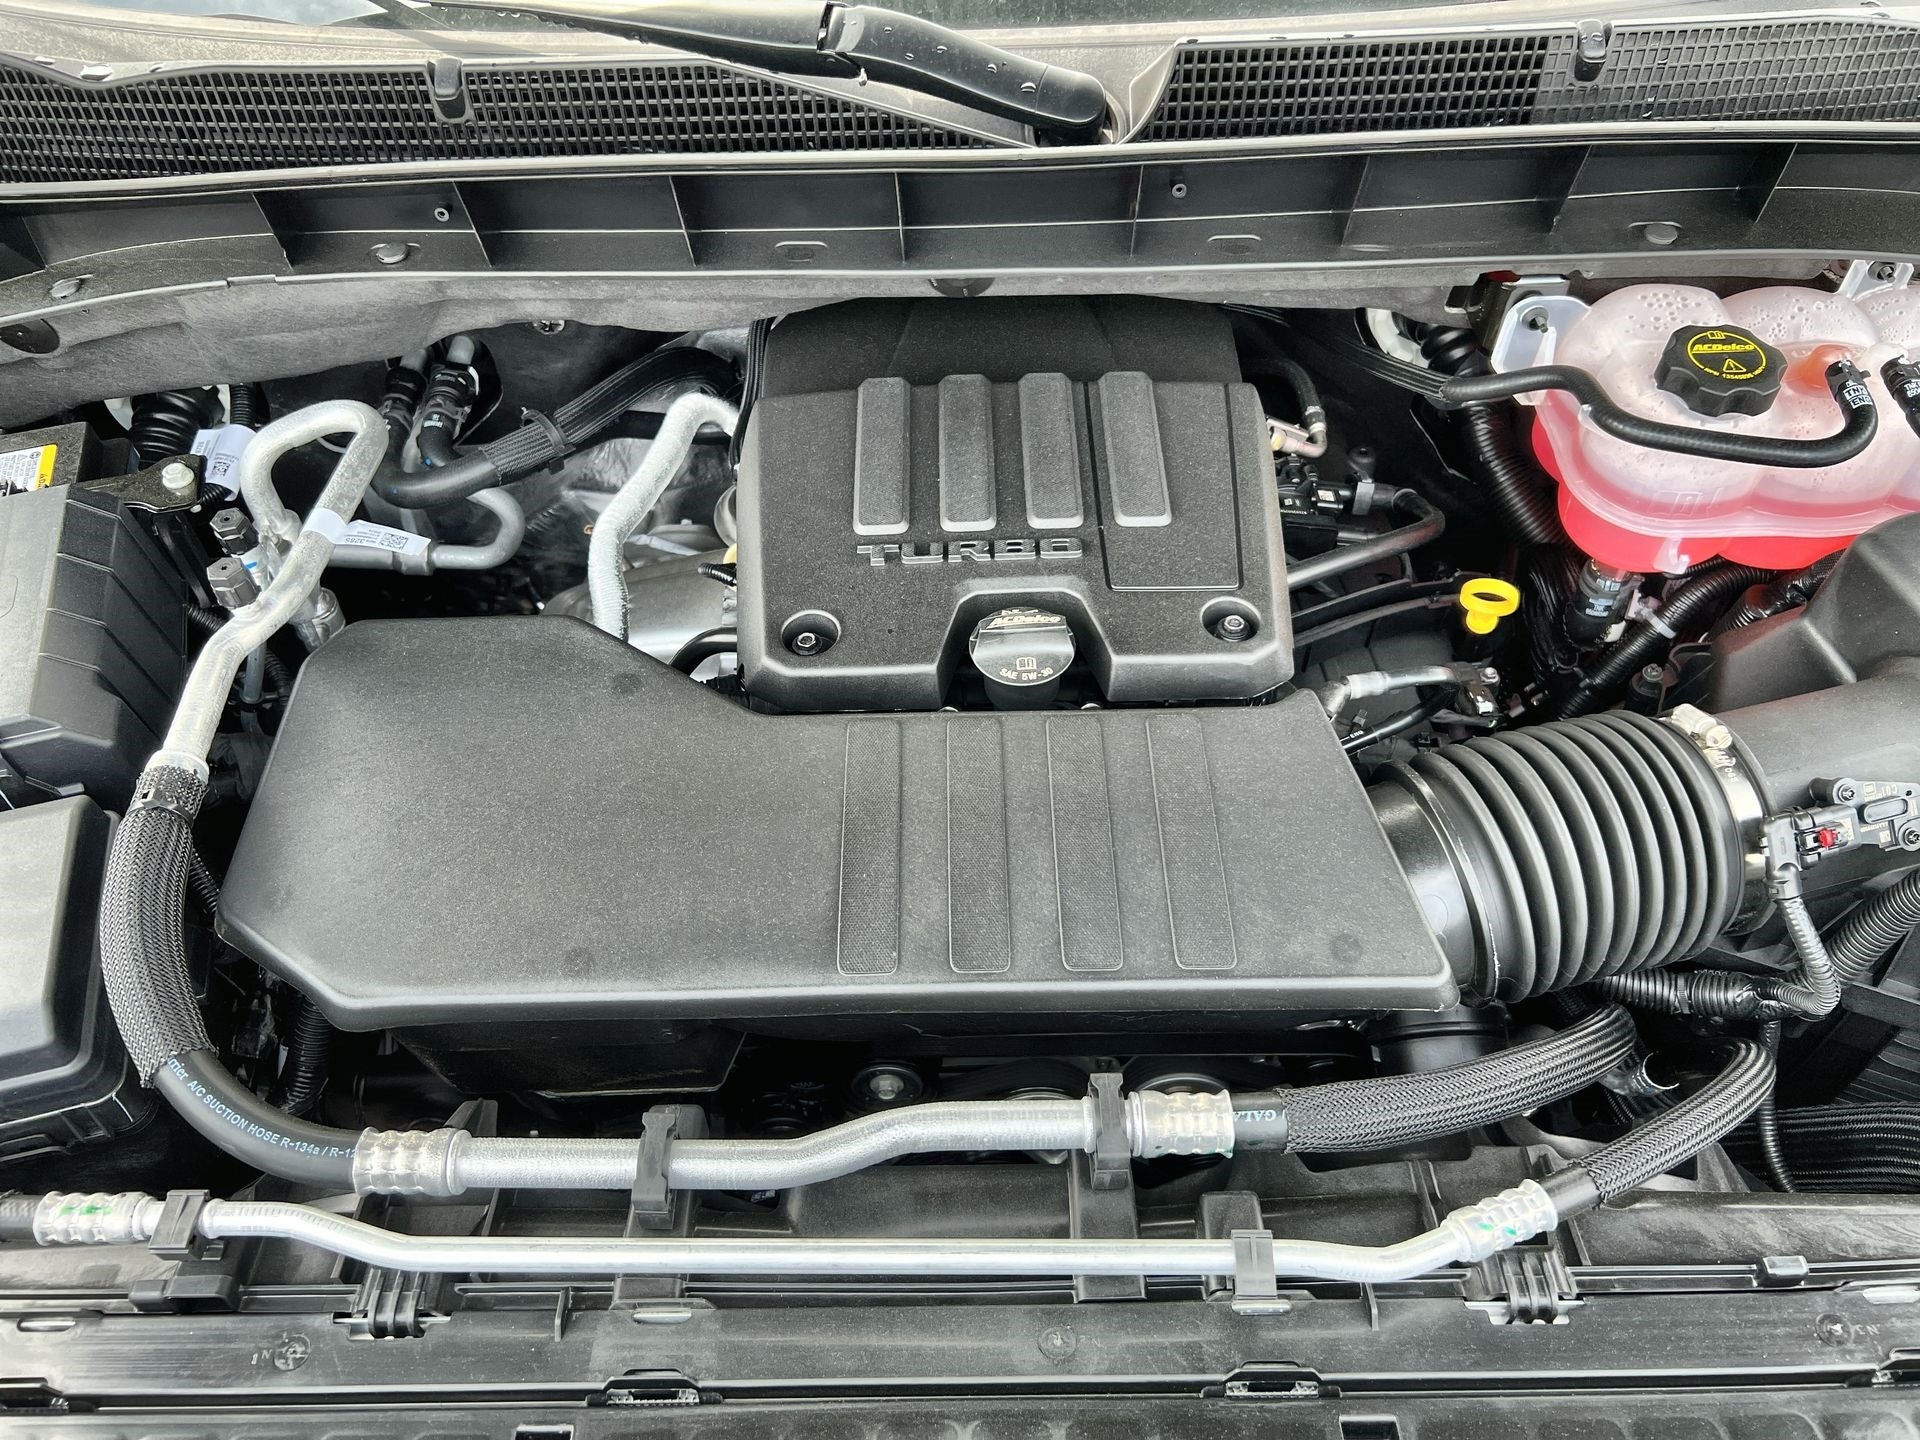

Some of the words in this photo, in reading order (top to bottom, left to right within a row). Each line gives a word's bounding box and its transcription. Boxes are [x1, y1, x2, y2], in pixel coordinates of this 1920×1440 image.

[1692, 343, 1755, 353] ACDelco
[856, 538, 1083, 567] TURBO
[986, 615, 1061, 629] ACDelco
[1000, 668, 1018, 679] SAE
[1022, 667, 1053, 680] 5W-30
[168, 1057, 189, 1080] rrier
[187, 1081, 206, 1096] A/C
[203, 1094, 249, 1129] SUCTION
[247, 1124, 281, 1144] HOSE
[280, 1137, 320, 1155] R-134a
